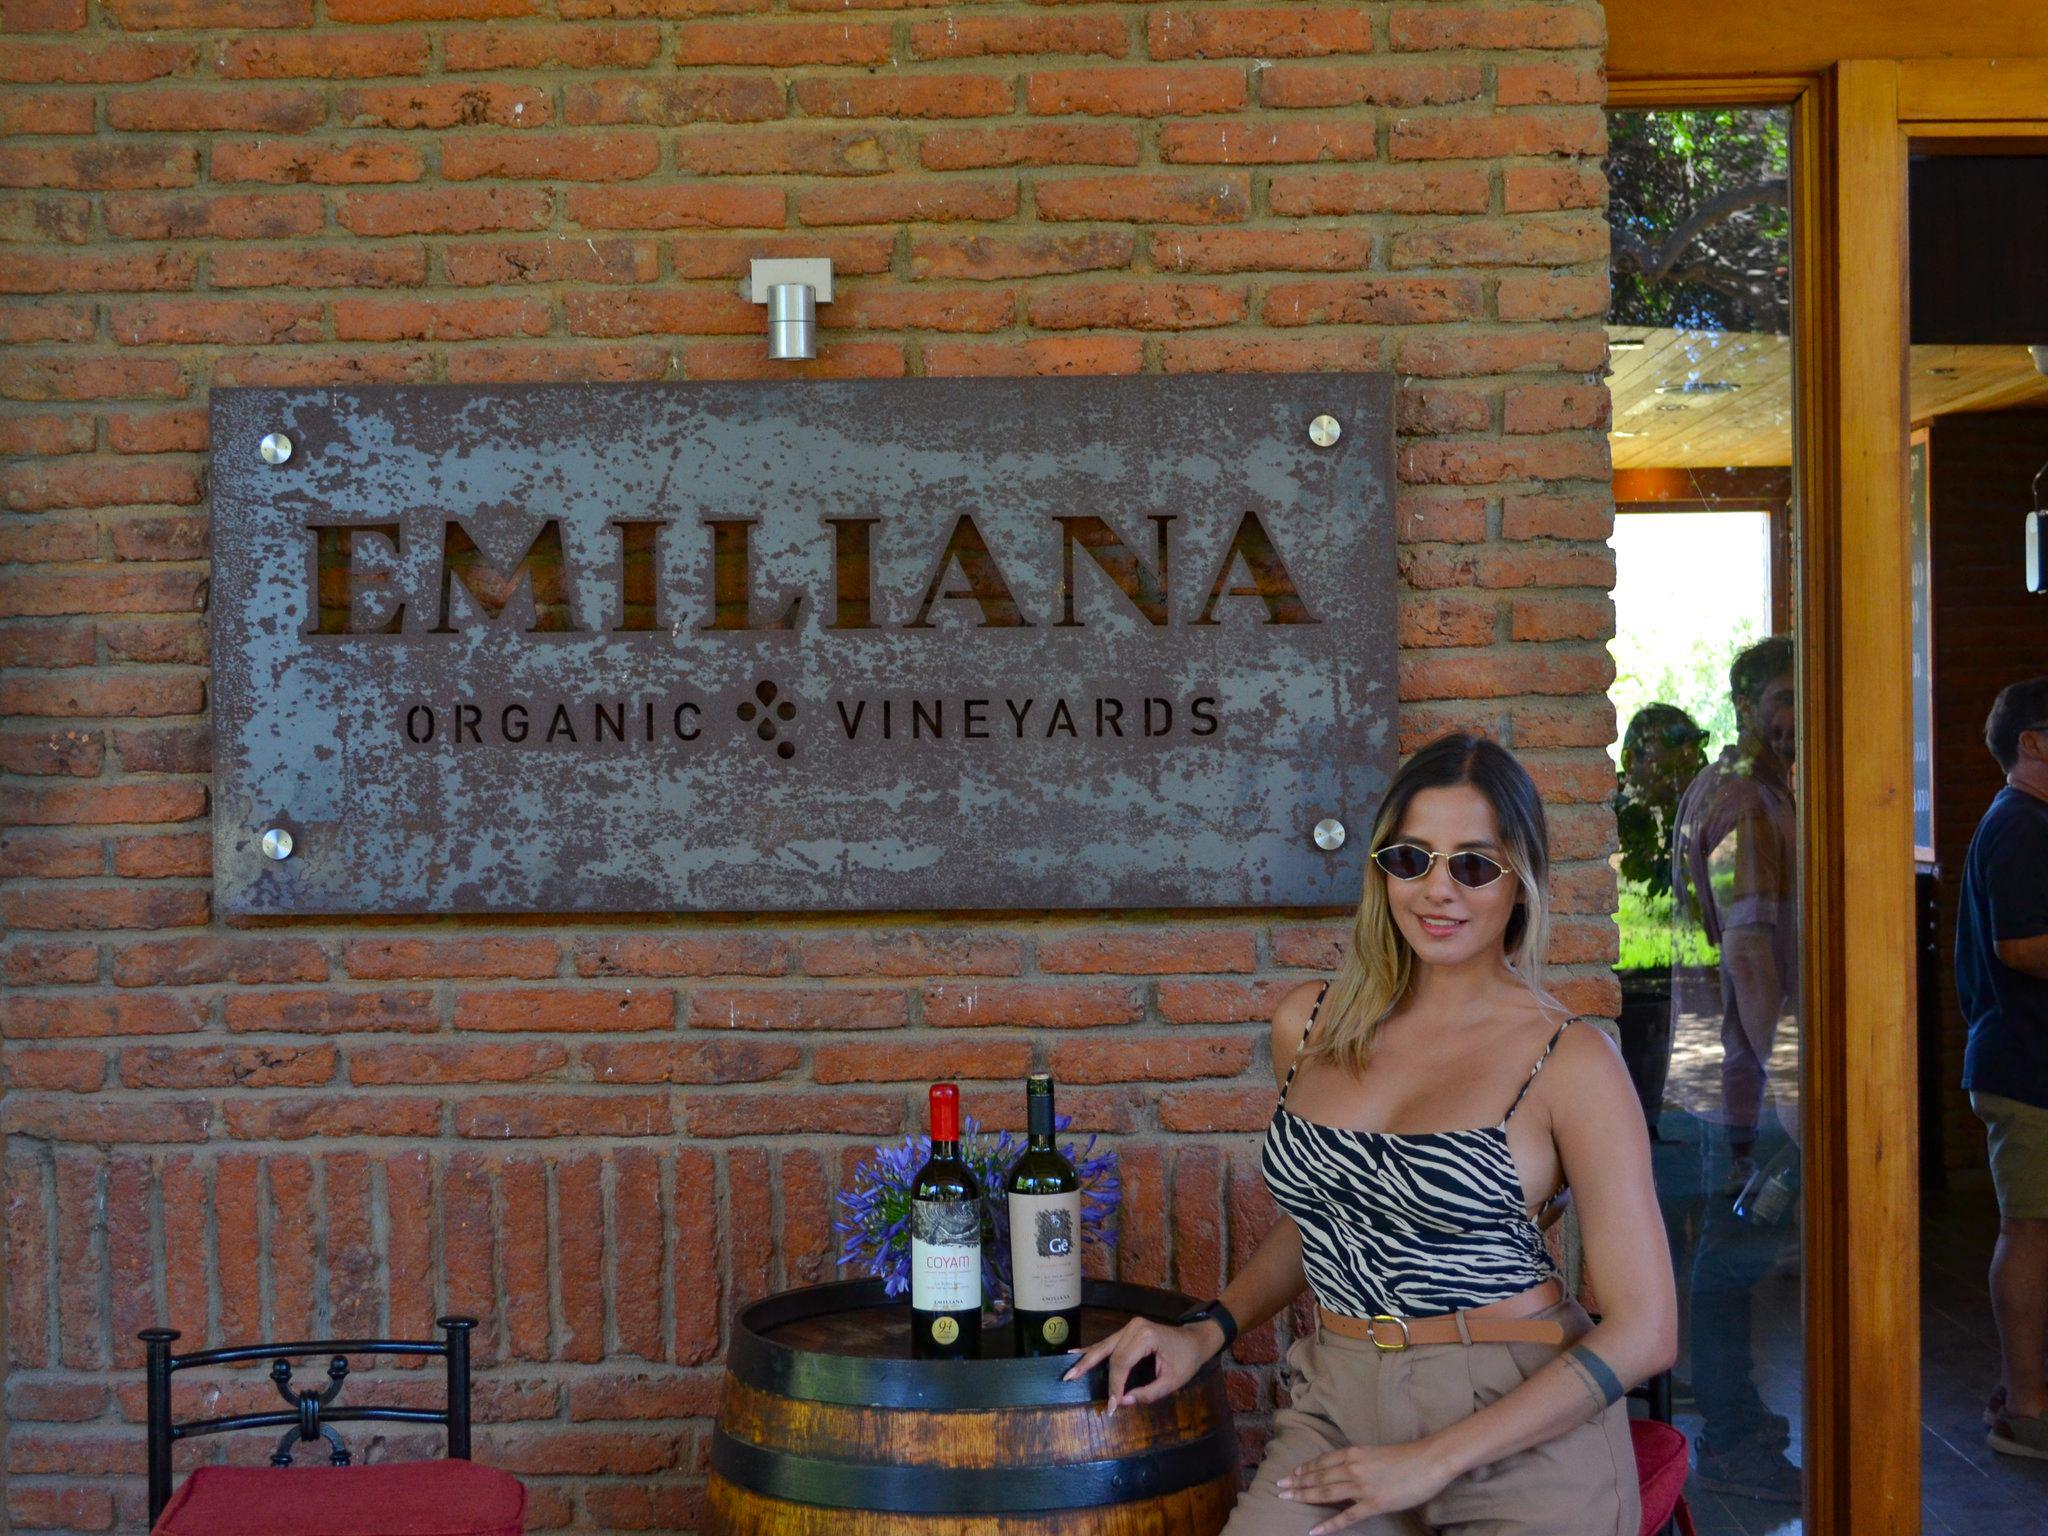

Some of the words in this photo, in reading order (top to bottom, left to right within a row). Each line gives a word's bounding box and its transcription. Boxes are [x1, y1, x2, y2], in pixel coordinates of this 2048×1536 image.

[306, 512, 1321, 634] EMILIANA
[406, 703, 702, 744] ORGANIC
[837, 696, 1219, 740] VINEYARDS
[1049, 1239, 1068, 1252] Gê
[927, 1256, 969, 1268] COYAM
[1049, 1322, 1063, 1335] 97
